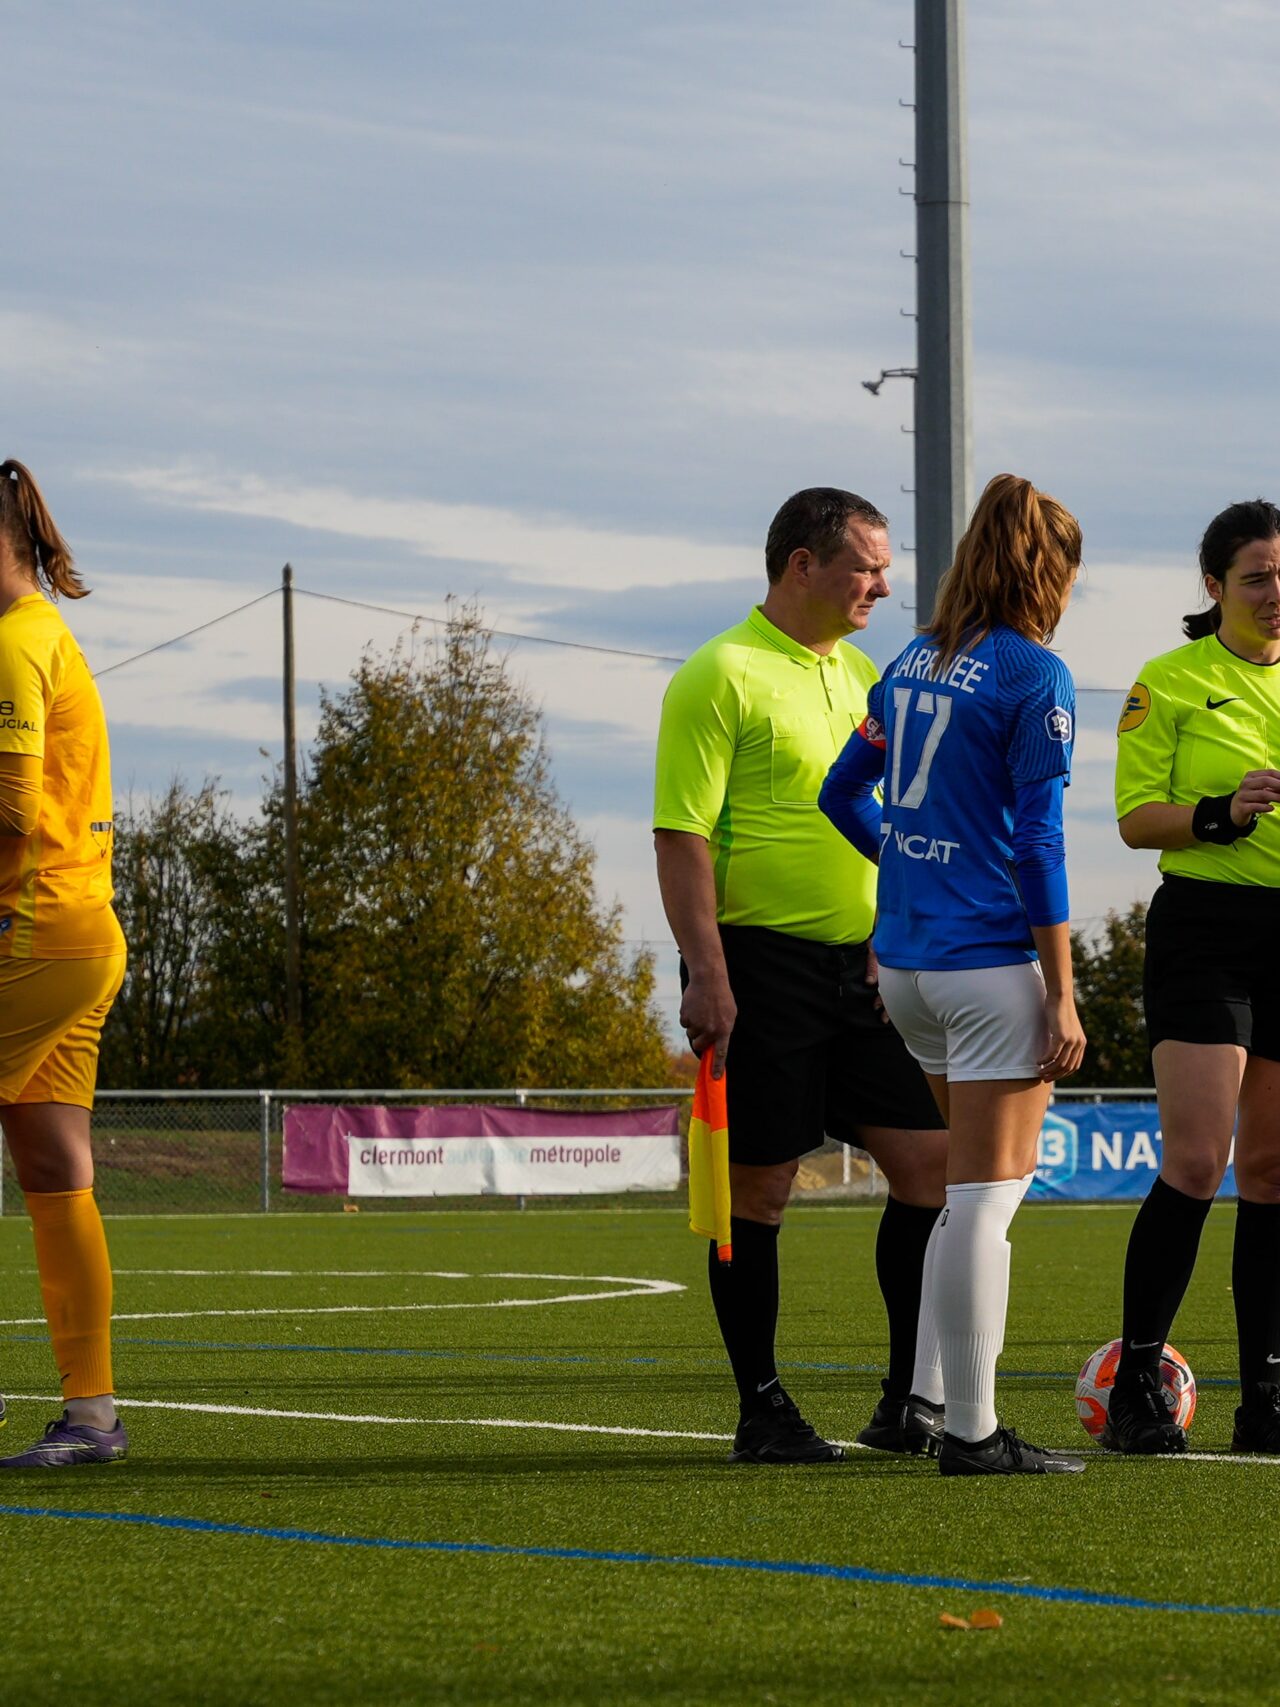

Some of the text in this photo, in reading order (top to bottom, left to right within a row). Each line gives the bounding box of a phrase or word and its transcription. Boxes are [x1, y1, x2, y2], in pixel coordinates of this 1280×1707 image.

[890, 687, 953, 809] 17
[360, 1146, 444, 1166] clermont
[530, 1144, 621, 1168] métropole
